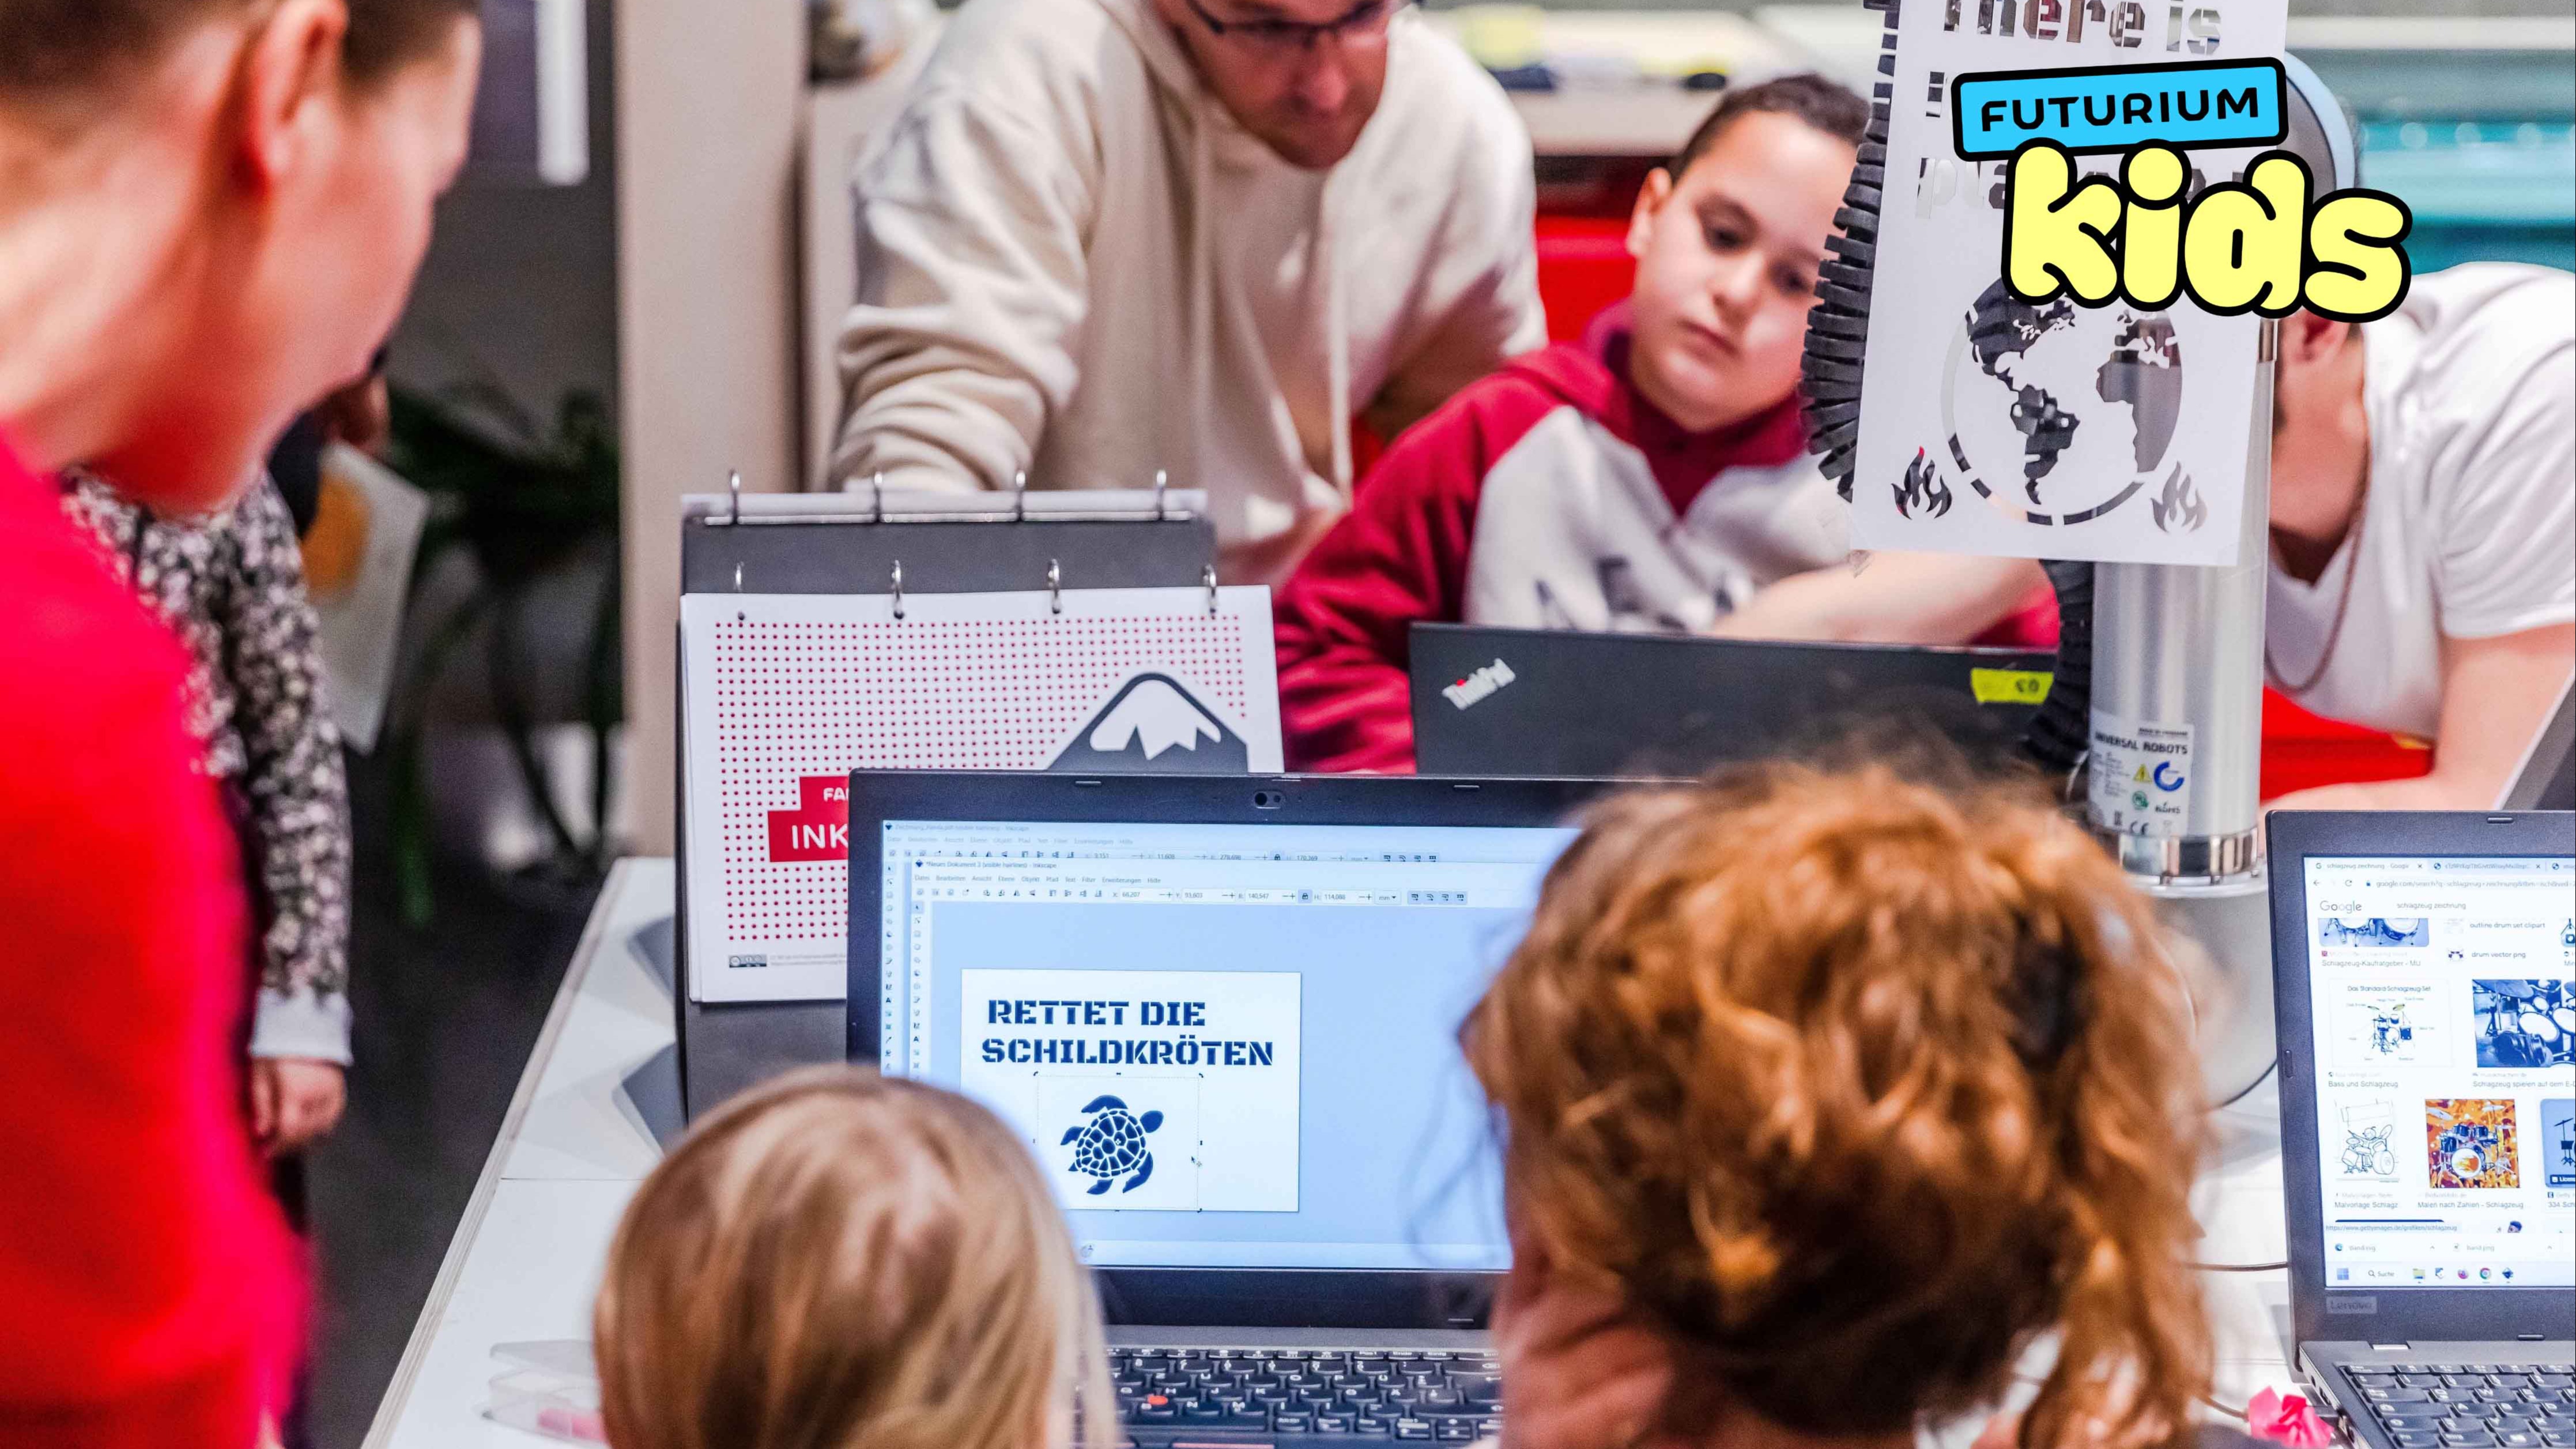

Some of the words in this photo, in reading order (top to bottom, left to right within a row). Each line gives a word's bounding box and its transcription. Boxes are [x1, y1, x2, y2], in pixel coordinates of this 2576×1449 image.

[2166, 0, 2221, 55] is
[2143, 742, 2188, 755] ROBOTS
[823, 788, 849, 802] FA
[2319, 900, 2362, 914] Google
[988, 999, 1129, 1025] RETTET
[1141, 1001, 1205, 1026] DIE
[982, 1034, 1273, 1066] SCHILDKRÖTEN
[2377, 1270, 2394, 1278] Suche
